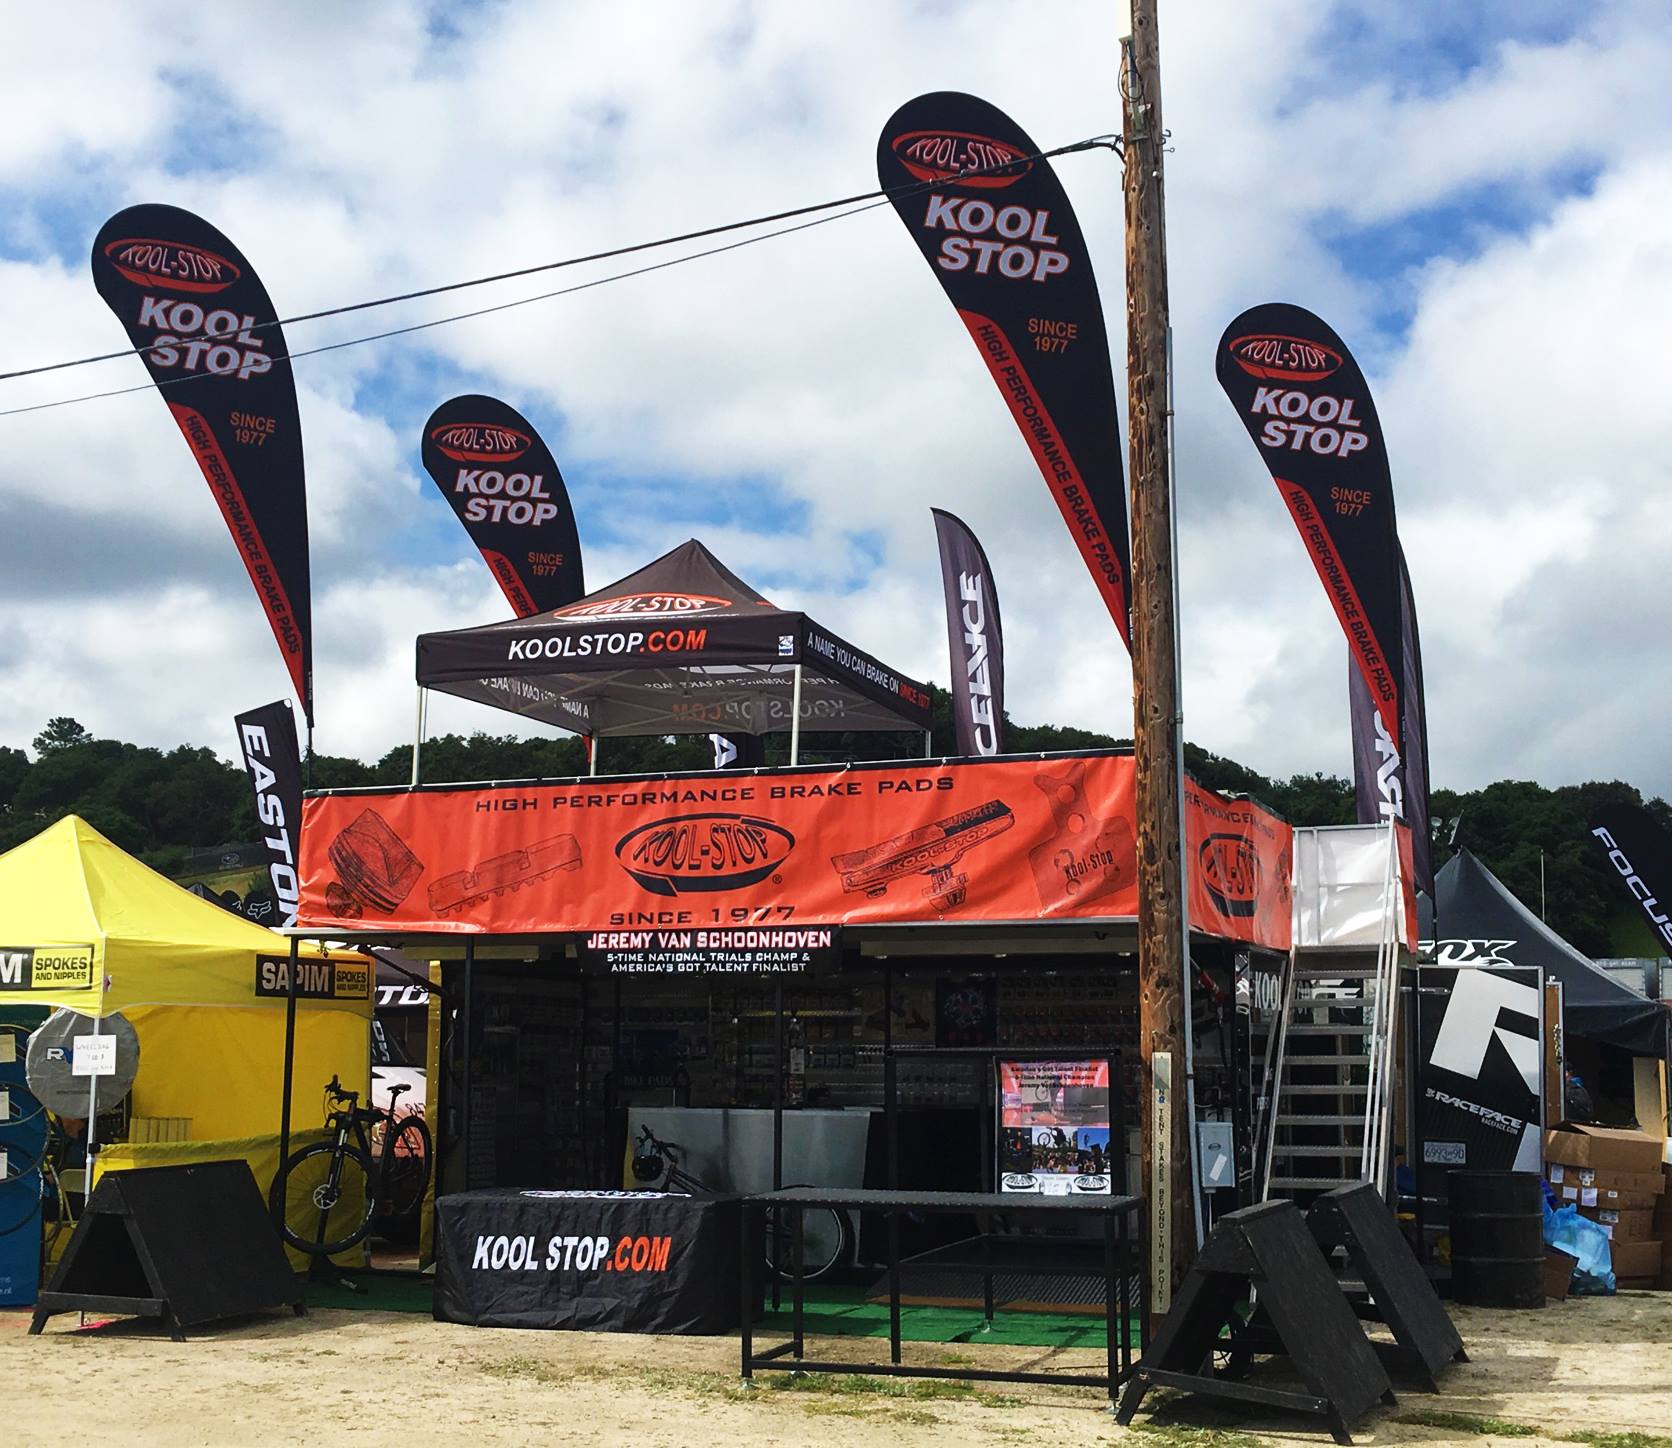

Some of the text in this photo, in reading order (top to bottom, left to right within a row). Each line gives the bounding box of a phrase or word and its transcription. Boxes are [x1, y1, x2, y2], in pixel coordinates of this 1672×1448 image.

[906, 138, 1013, 171] KOOL-STOP
[924, 195, 1059, 245] KOOL
[119, 245, 222, 281] KOOL-STOP
[937, 236, 1070, 282] STOP
[138, 296, 264, 347] KOOL
[1028, 318, 1077, 339] SINCE
[149, 335, 272, 380] STOP
[1033, 336, 1069, 354] 1977
[1241, 340, 1326, 369] KOOL-STOP
[1251, 387, 1361, 427] KOOL
[229, 411, 276, 433] SINCE
[235, 428, 267, 446] 1977
[442, 428, 517, 449] KOOL-STOP
[1260, 420, 1369, 458] STOP
[978, 324, 1119, 585] HIGH PERFORMANCE BRAKE PADS
[456, 469, 550, 498] KOOL
[1330, 486, 1372, 504] SINCE
[464, 498, 558, 526] STOP
[1335, 501, 1363, 517] 1977
[186, 415, 300, 654] HIGH PERFORMANCE BRAKE PADS
[528, 552, 564, 566] SINCE
[531, 565, 557, 576] 1977
[569, 597, 706, 615] KOOL-STOP
[1290, 490, 1394, 702] HIGH PERFORMANCE BRAKE PADS
[508, 629, 707, 660] KOOLSTOP.COM
[814, 635, 836, 660] NAME
[836, 646, 852, 668] YOU
[851, 656, 867, 676] CAN
[866, 664, 888, 689] BRAKE
[889, 677, 900, 694] ON
[476, 777, 953, 812] HIGH PERFORMANCE BRAKE PADS
[633, 823, 769, 870] KOOL-STOP
[1063, 850, 1114, 881] Kool-Stop
[610, 906, 795, 925] SINCE 1977
[588, 931, 831, 949] JEREMY VAN SCHOONHOVEN
[35, 957, 87, 971] SPOKES
[607, 952, 810, 962] 5-TIME NATIONAL TRIALS CHAMP &
[611, 962, 806, 973] AMERICA'S GOT TALENT FINALIST
[35, 971, 87, 980] AND NIPPLES
[336, 970, 366, 983] SPOKES
[1435, 1091, 1522, 1129] RACEFACE
[472, 1236, 671, 1271] KOOL STOP.COM
